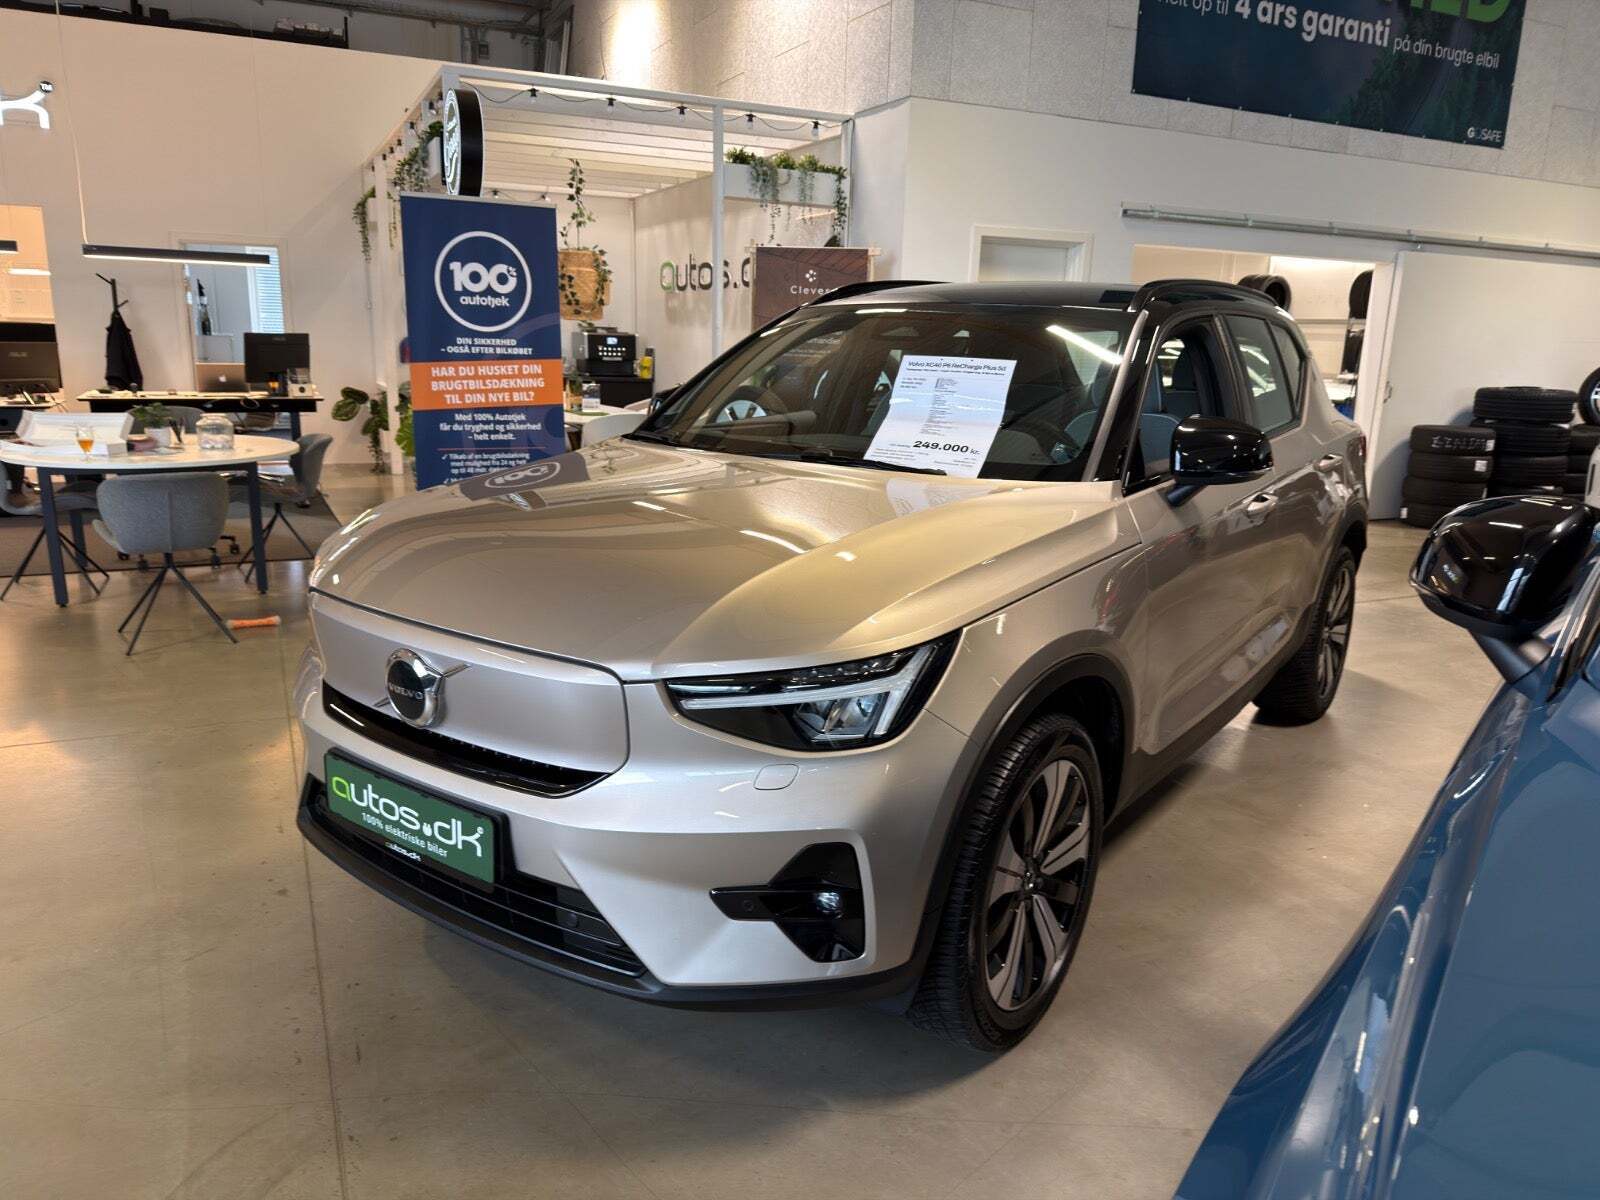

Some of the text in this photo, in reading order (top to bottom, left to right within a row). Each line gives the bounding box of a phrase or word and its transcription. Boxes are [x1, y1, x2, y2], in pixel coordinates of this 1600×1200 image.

[1235, 0, 1251, 19] 4
[1302, 9, 1392, 48] garanti
[1393, 34, 1411, 55] på
[1412, 39, 1433, 56] din
[1434, 41, 1474, 67] brugte
[1476, 50, 1500, 69] elbil
[459, 294, 510, 309] autotjek
[456, 337, 517, 346] DIN SIKKERHED
[471, 346, 495, 354] EFTER
[431, 364, 542, 377] HAR DU HUSKET DIN
[952, 363, 982, 371] ReCharge
[431, 377, 545, 391] BRUGTBILSDÆKNING
[444, 391, 535, 404] TIL DIN NYE BIL?
[454, 413, 473, 421] Med
[494, 413, 526, 422] Autotjek
[452, 422, 464, 431] du
[464, 423, 494, 433] tryghed
[495, 424, 505, 432] og
[505, 422, 542, 431] sikkerhed
[912, 440, 969, 453] 249.000
[332, 776, 485, 858] autos.dk
[362, 812, 448, 858] 100% elektriske biler
